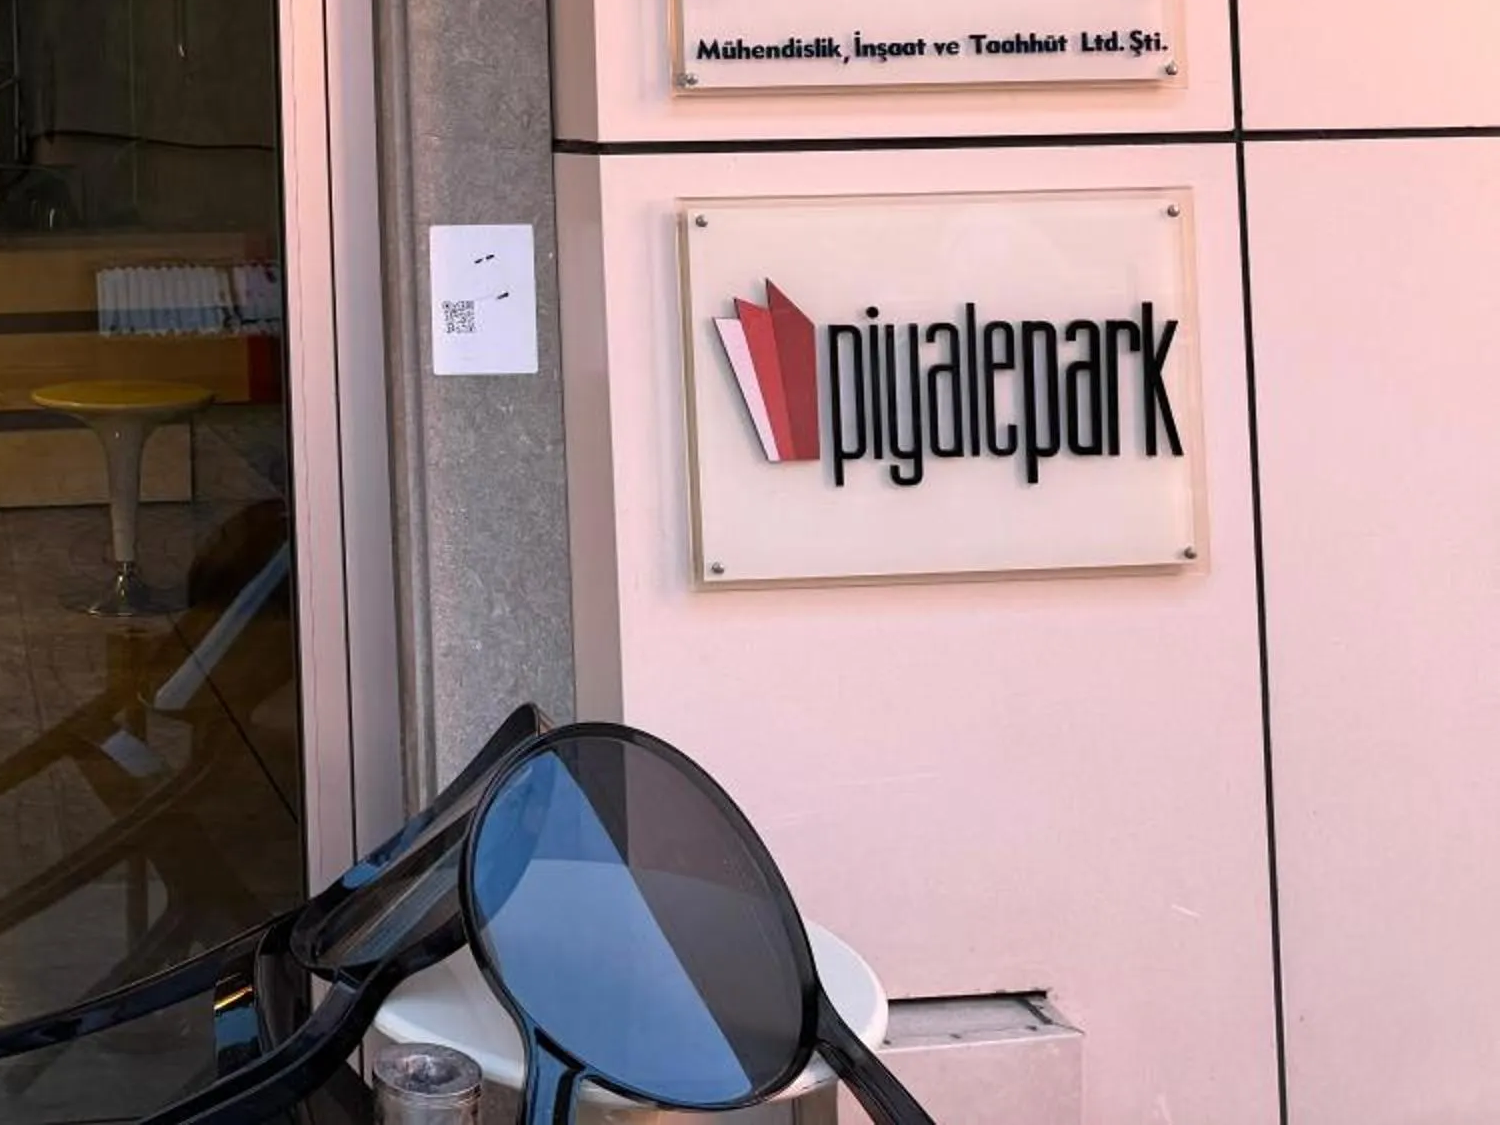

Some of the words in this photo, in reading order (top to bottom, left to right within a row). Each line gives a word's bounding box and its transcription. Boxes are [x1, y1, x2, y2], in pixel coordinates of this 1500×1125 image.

[696, 37, 850, 64] Mühendislik,
[854, 31, 927, 62] İnşaat
[934, 41, 960, 56] ve
[969, 32, 1068, 55] Taahhüt
[1080, 30, 1125, 53] Ltd.
[1129, 29, 1168, 57] Şti.
[827, 301, 1185, 487] piyalepark
